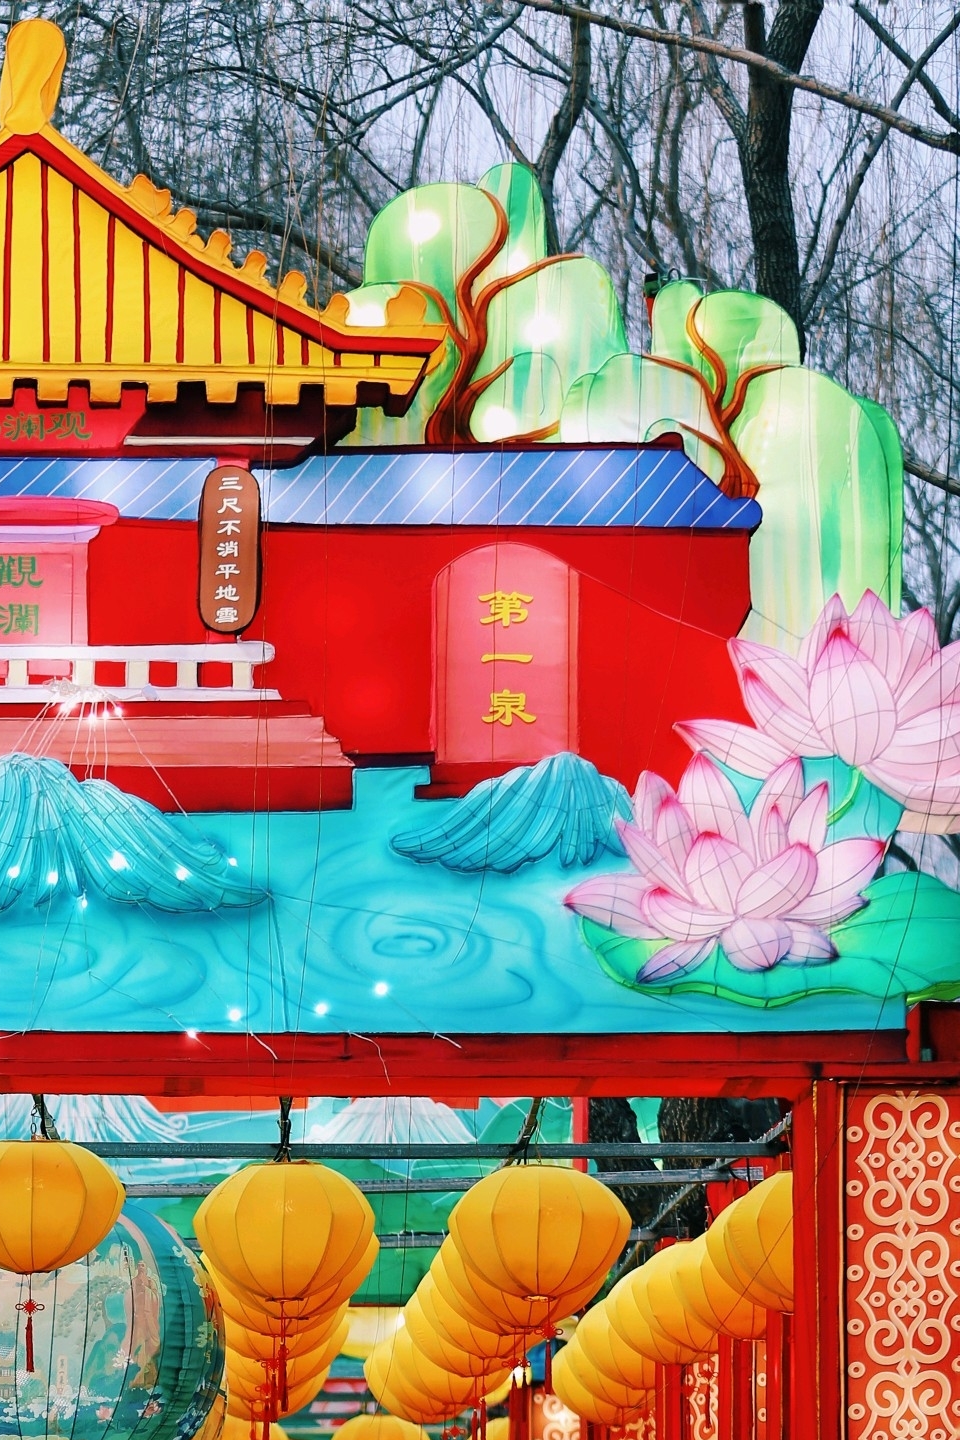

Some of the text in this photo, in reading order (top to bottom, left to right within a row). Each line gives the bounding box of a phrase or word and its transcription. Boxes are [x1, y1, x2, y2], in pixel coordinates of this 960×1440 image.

[214, 476, 244, 624] 三尺不消平地雪
[478, 590, 537, 726] 第一泉
